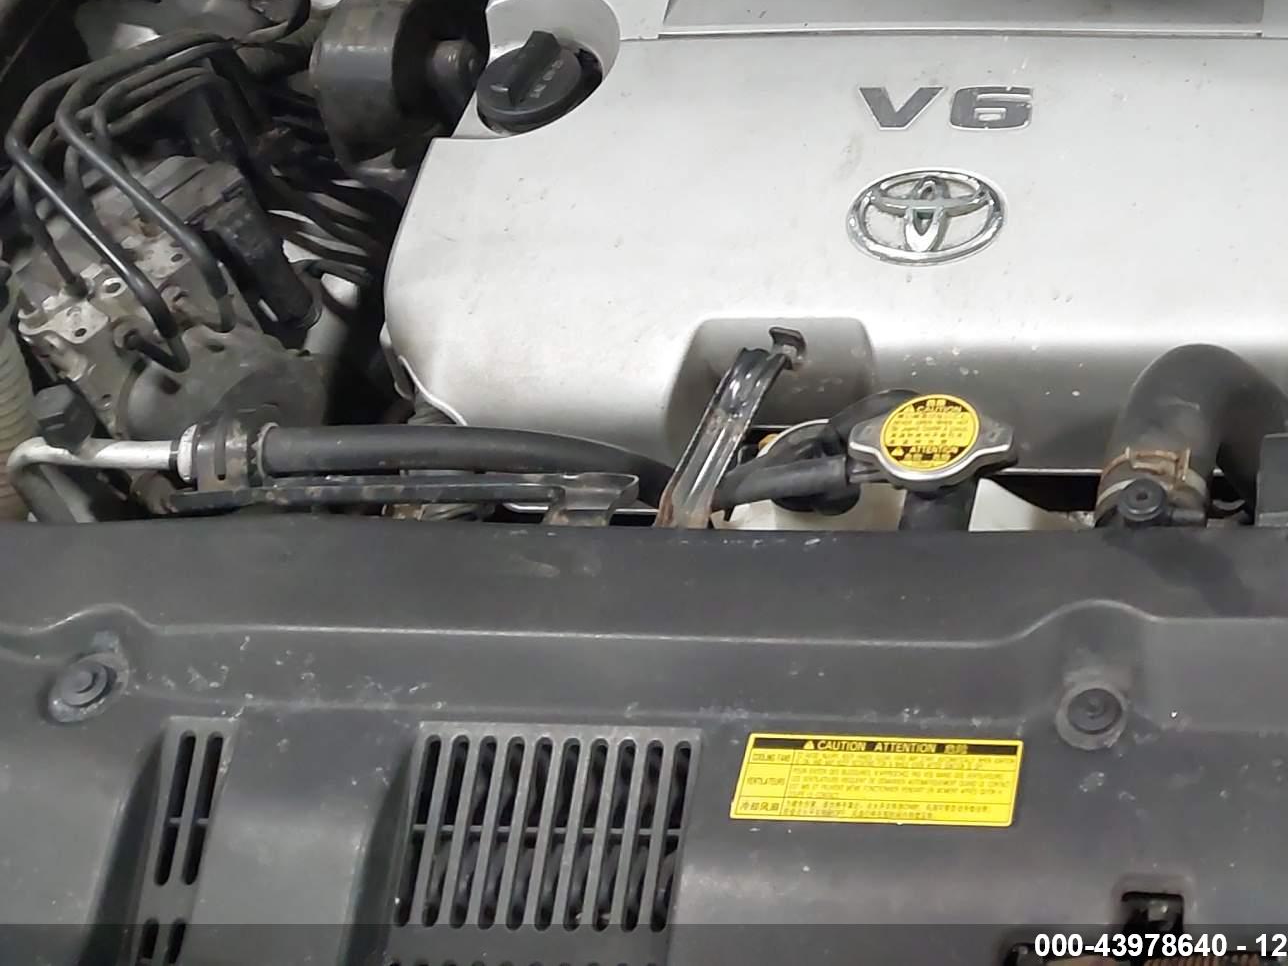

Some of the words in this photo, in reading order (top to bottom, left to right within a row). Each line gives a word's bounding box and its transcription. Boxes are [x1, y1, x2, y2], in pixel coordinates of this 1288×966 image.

[858, 85, 1033, 130] V6
[816, 740, 867, 751] CAUTION
[874, 742, 937, 753] ATTENTION
